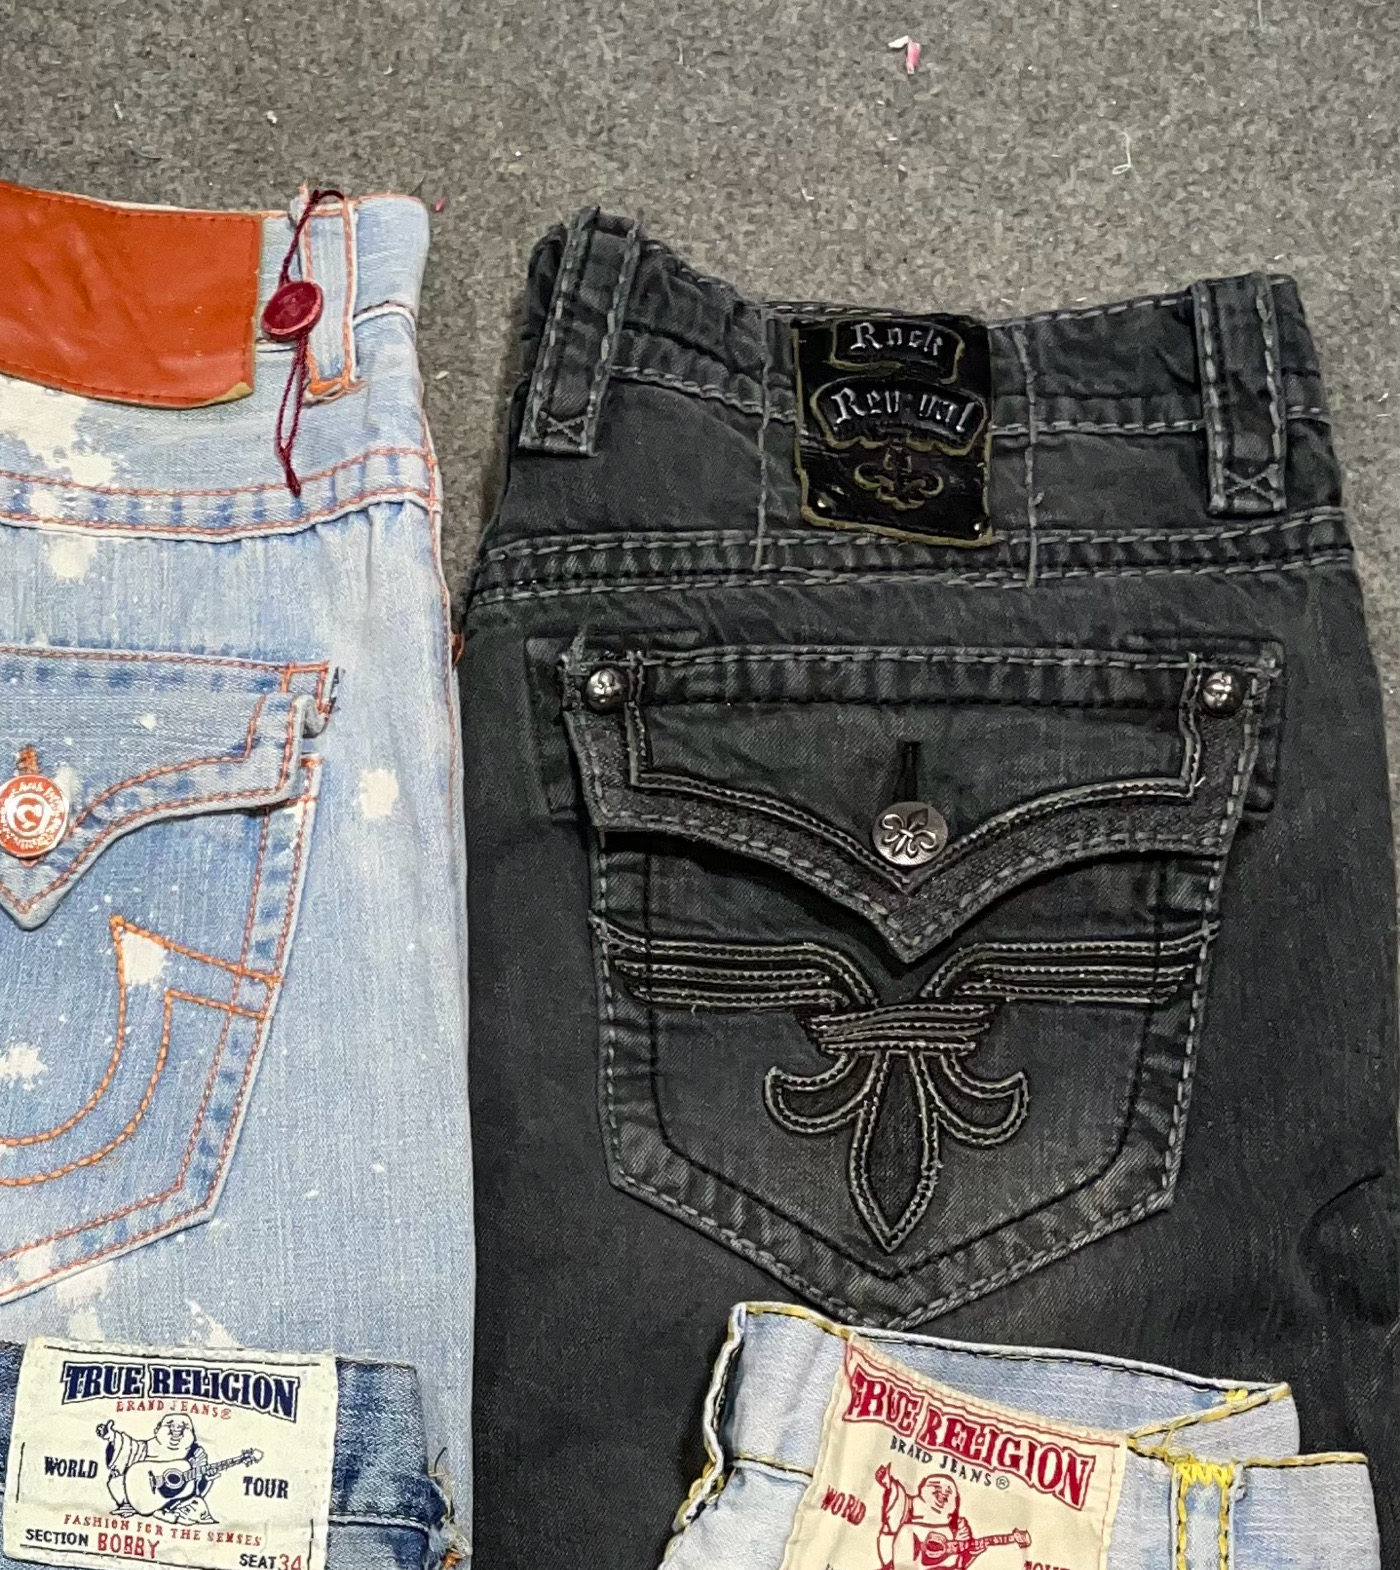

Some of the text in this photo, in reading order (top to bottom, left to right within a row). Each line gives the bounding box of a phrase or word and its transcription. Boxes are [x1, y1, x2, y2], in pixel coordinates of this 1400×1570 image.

[63, 1361, 299, 1422] TRUE RELIGION
[116, 1400, 165, 1412] BRAND
[844, 1367, 1095, 1509] TRUE RELIGION
[890, 1436, 932, 1464] BRAND
[44, 1456, 98, 1478] WORLD
[243, 1476, 288, 1499] TOUR
[821, 1484, 865, 1525] WORLD
[64, 1513, 262, 1547] FASHION FOR THE SENSES
[25, 1528, 88, 1547] SECTION
[98, 1532, 160, 1559] BOBBY
[239, 1553, 277, 1570] SEAT
